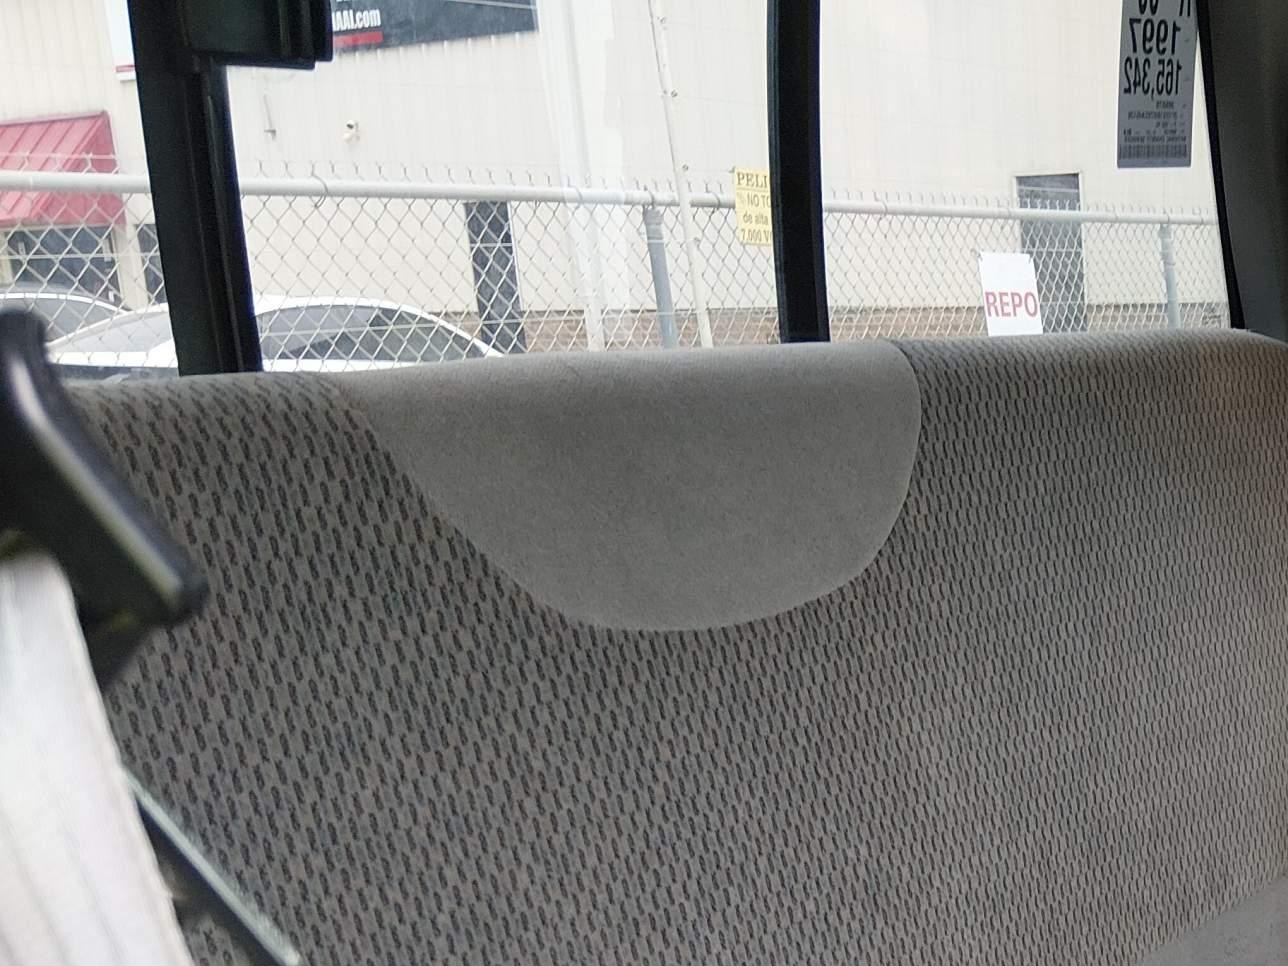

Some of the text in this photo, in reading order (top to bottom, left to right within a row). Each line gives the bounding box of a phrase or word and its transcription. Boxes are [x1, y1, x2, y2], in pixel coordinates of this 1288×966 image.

[747, 192, 760, 207] NO
[743, 211, 769, 226] de alta
[985, 291, 1038, 318] REPO
